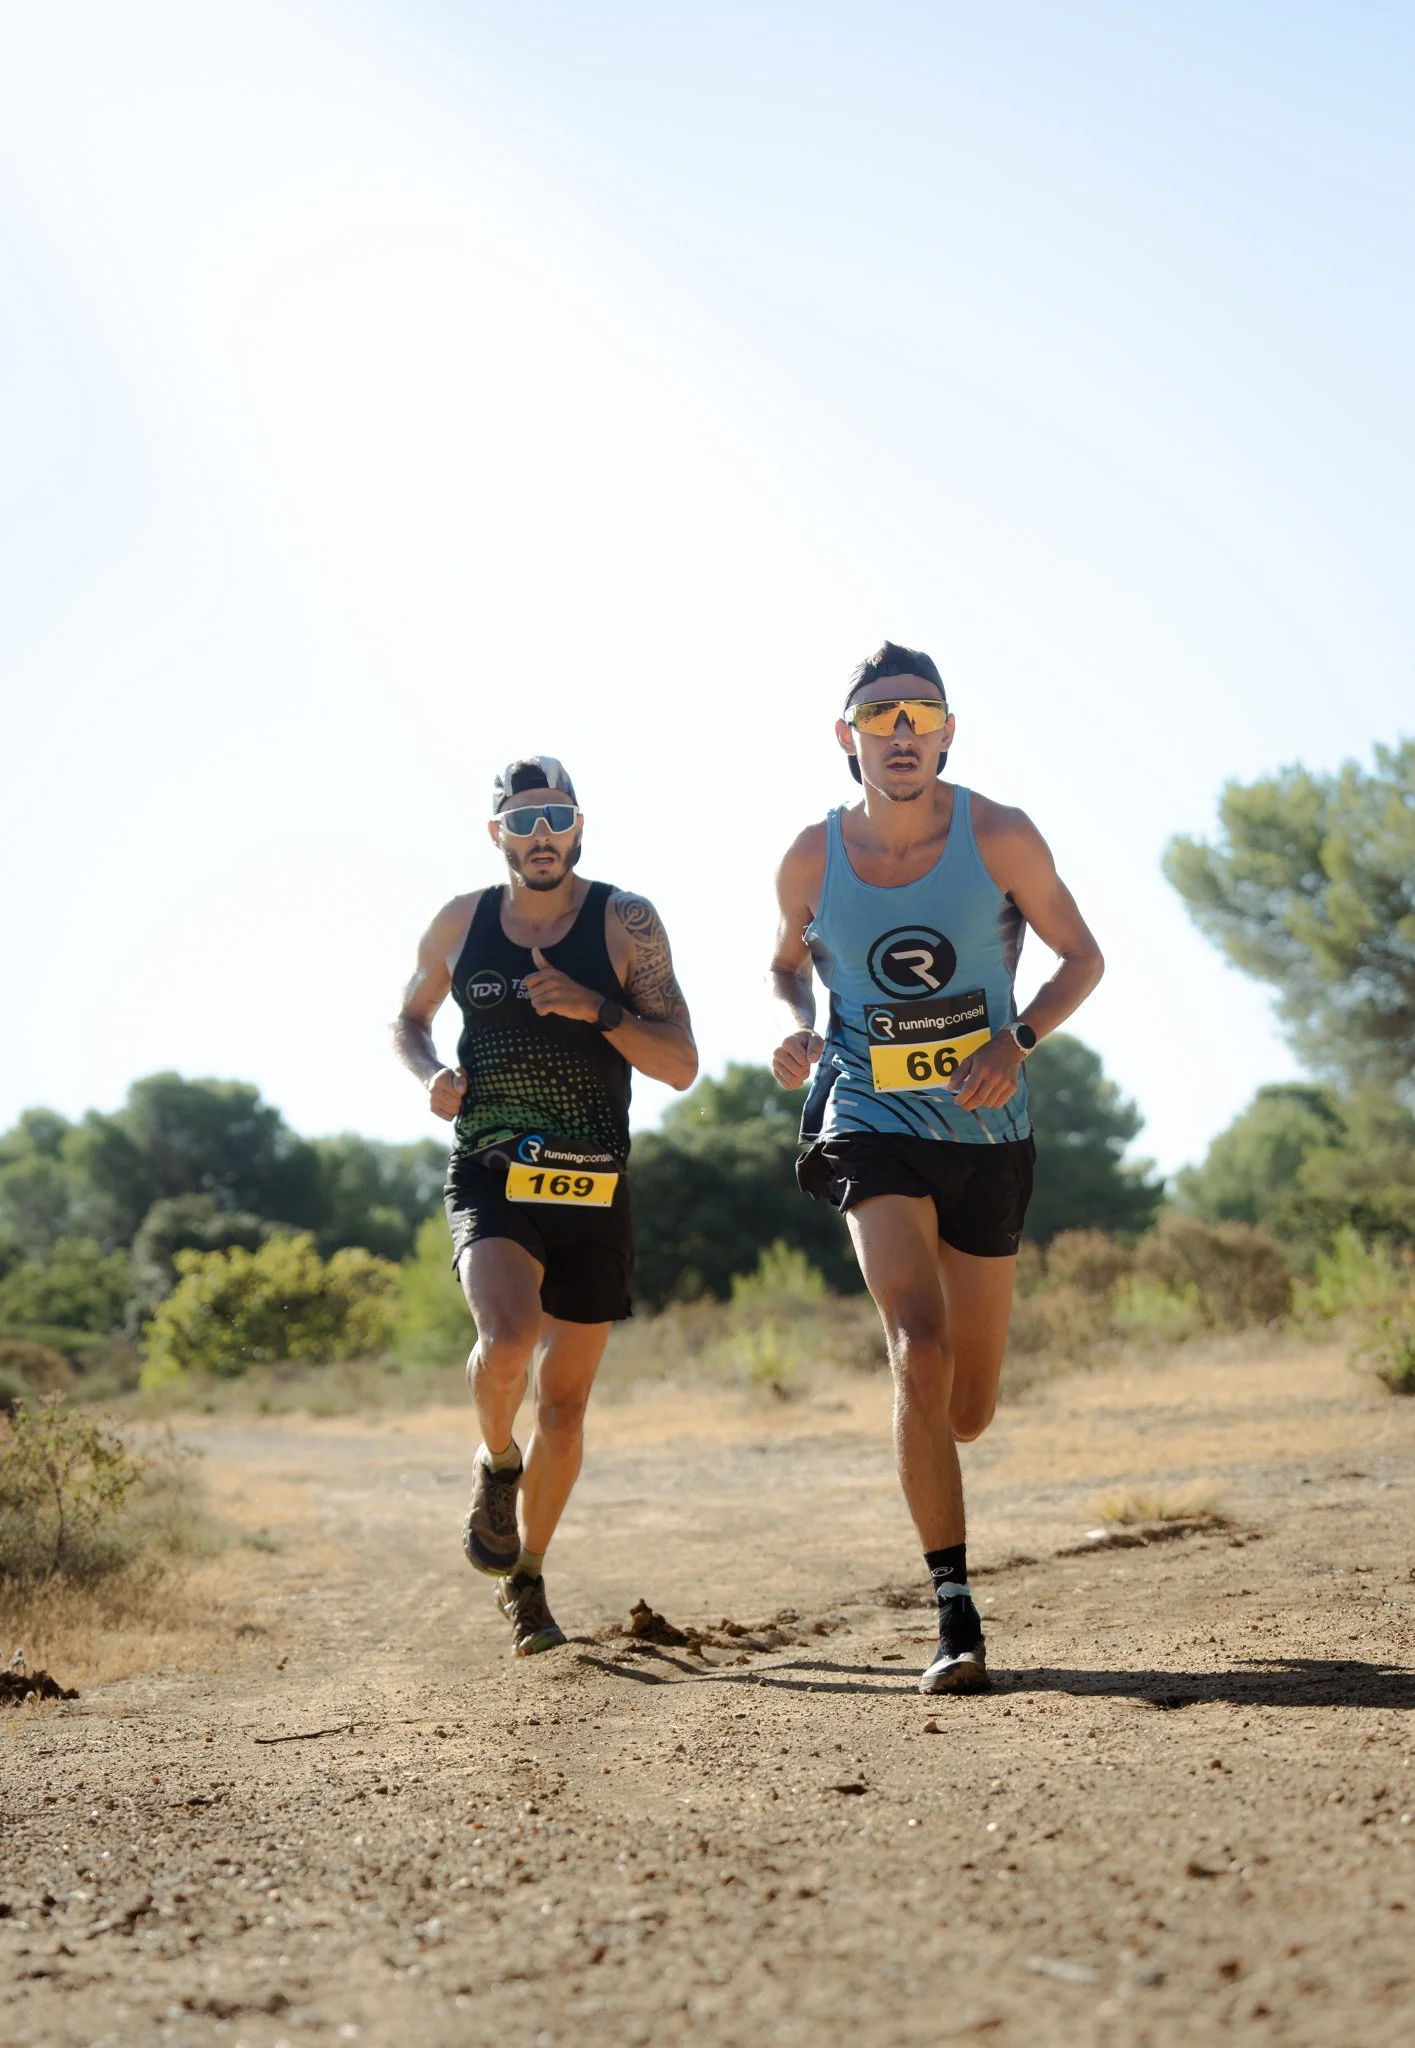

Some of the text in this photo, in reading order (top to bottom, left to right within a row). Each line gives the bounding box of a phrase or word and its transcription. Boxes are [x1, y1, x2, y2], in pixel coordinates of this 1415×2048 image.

[471, 983, 502, 998] TDR
[899, 1005, 984, 1031] runningconseil
[906, 1047, 959, 1081] 66
[528, 1173, 595, 1197] 169
